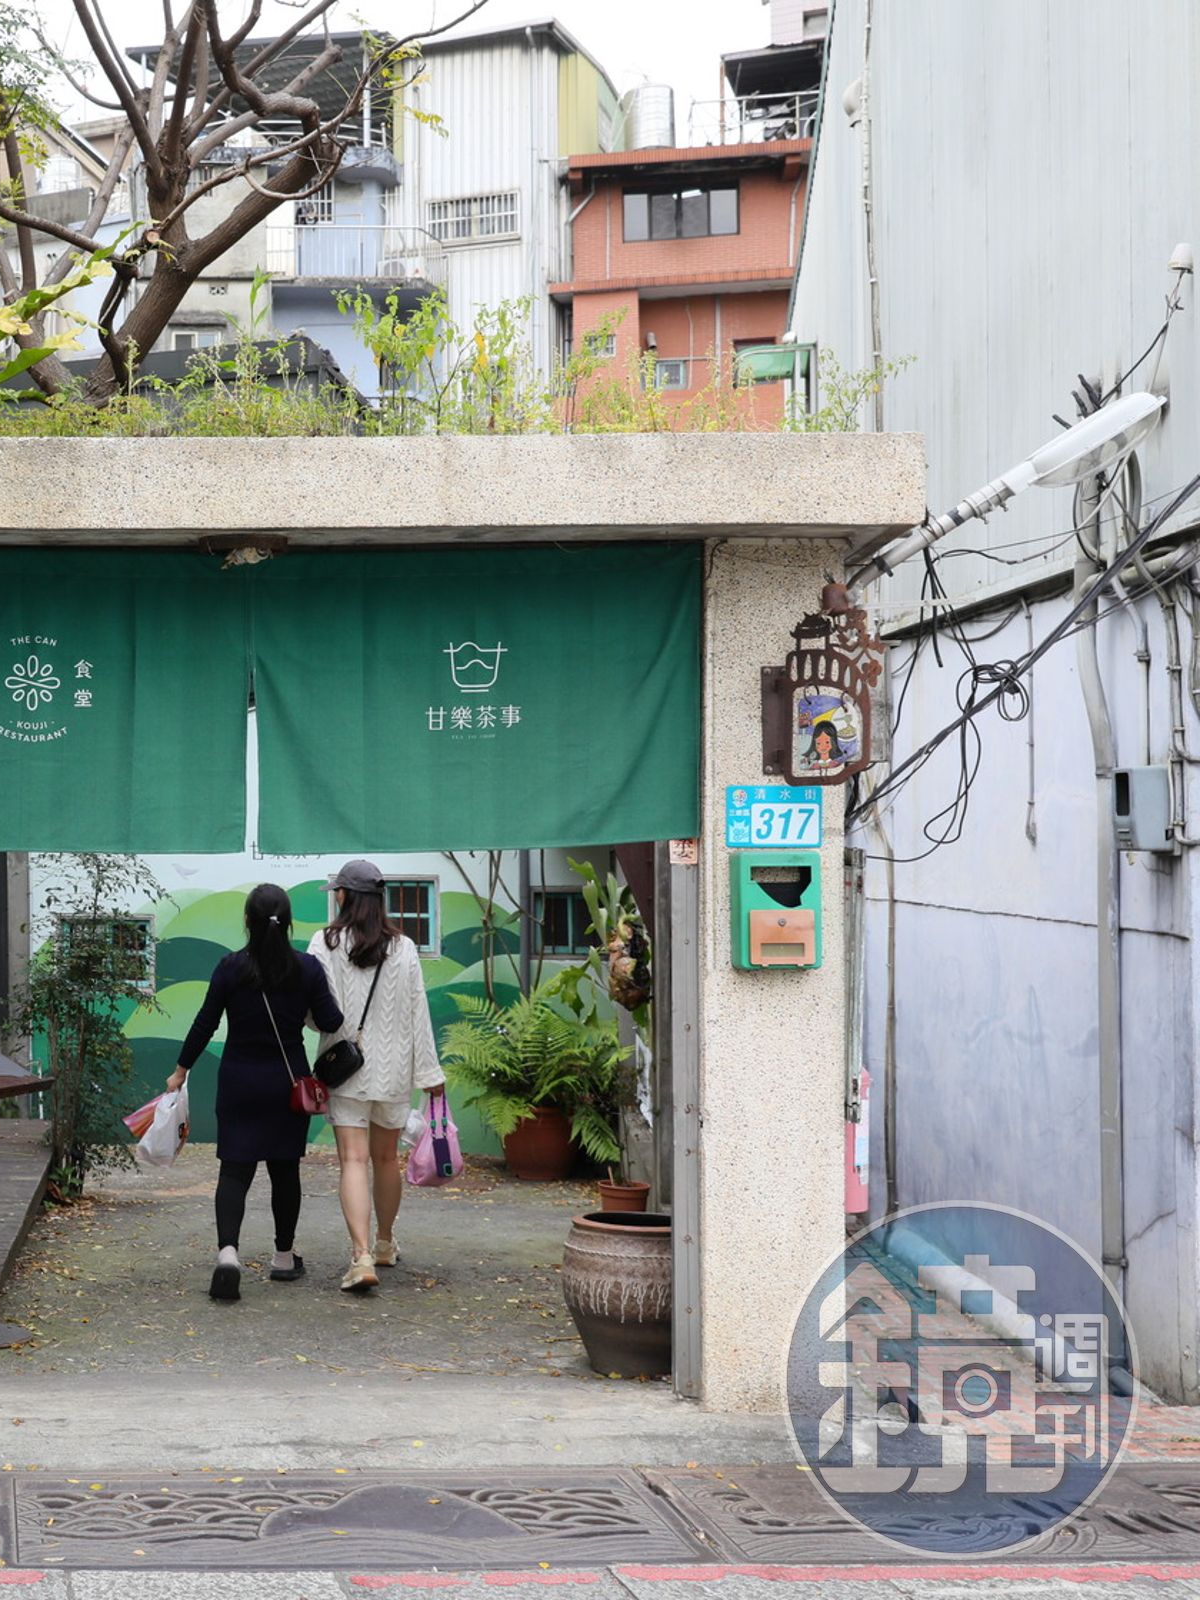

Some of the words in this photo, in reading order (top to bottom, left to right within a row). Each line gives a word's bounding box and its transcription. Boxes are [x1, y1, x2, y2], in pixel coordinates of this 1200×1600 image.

[10, 635, 31, 646] THE
[34, 635, 58, 647] CAN
[73, 659, 94, 707] 食堂
[16, 720, 48, 730] KOUJI
[425, 704, 522, 731] 甘樂茶事
[753, 788, 816, 800] 清水街
[756, 808, 815, 840] 317
